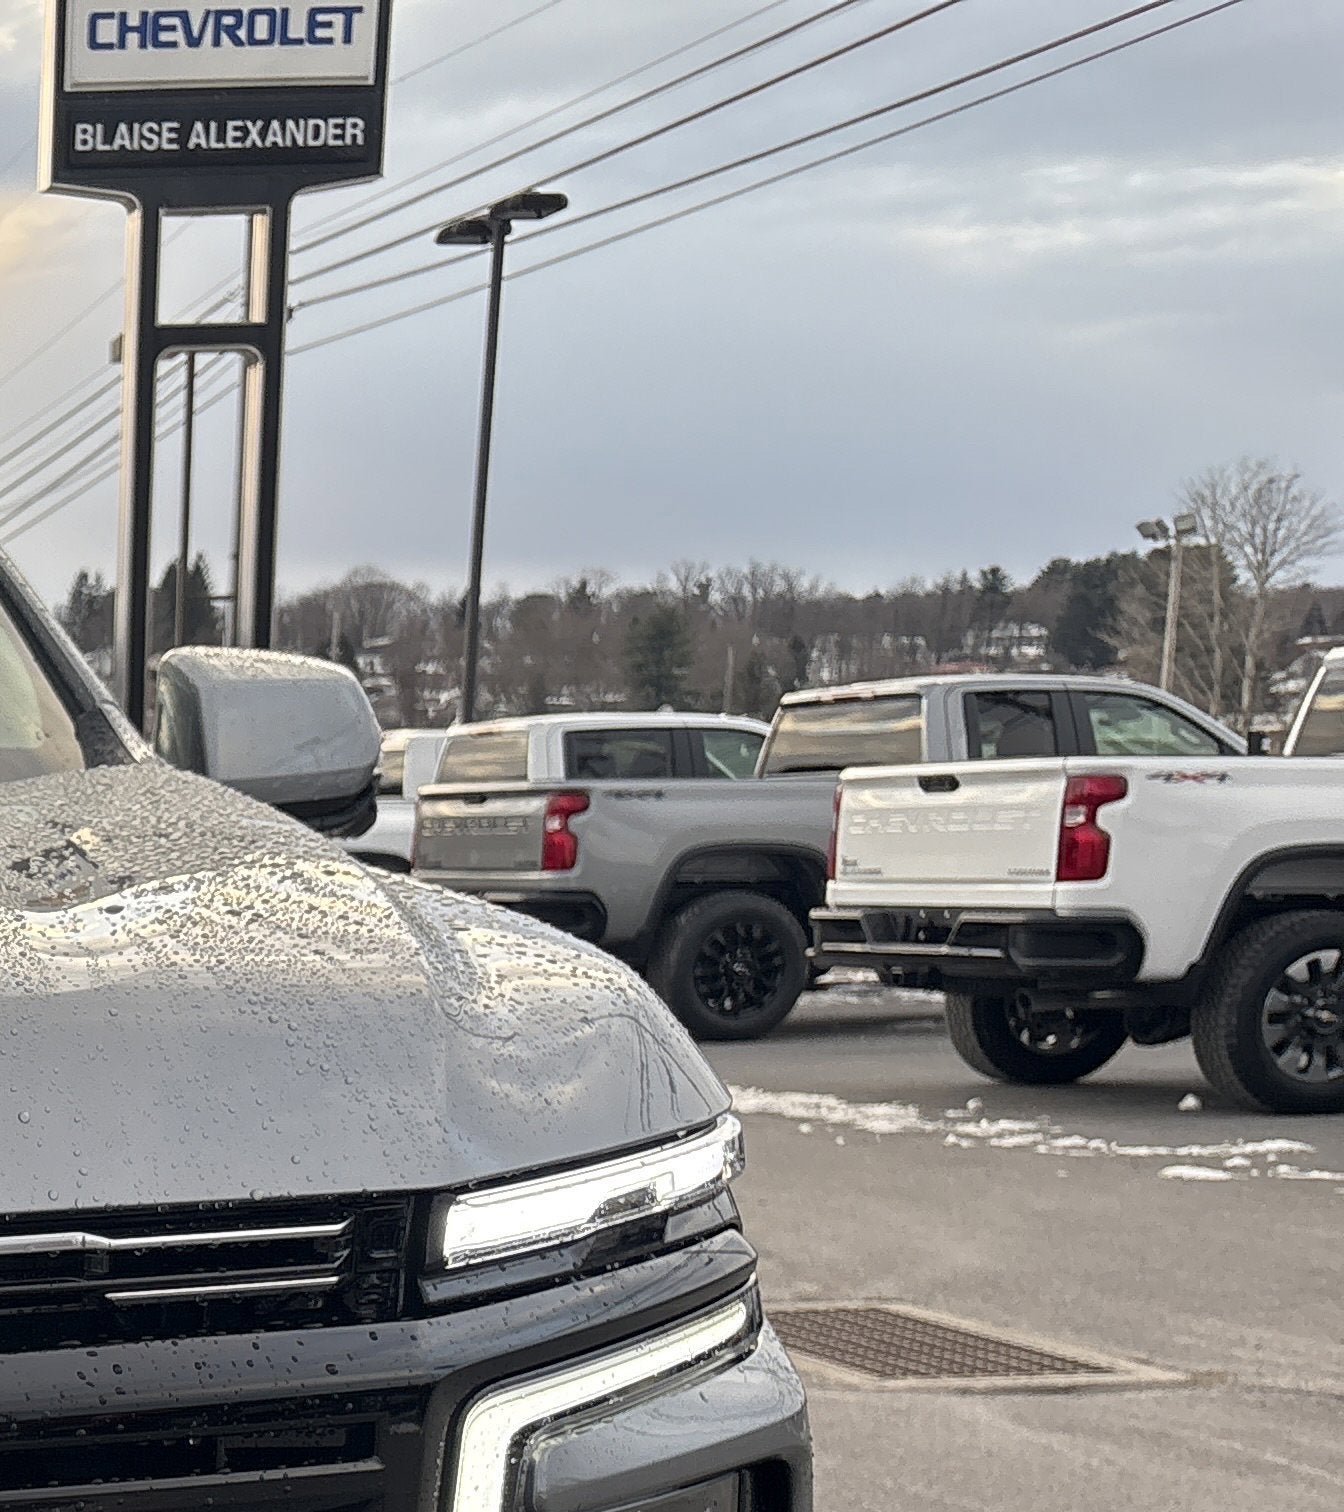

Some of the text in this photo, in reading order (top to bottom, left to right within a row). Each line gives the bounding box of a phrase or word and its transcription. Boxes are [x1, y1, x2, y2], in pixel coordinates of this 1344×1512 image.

[86, 6, 363, 50] CHEVROLET
[74, 117, 365, 152] BLAISE ALEXANDER
